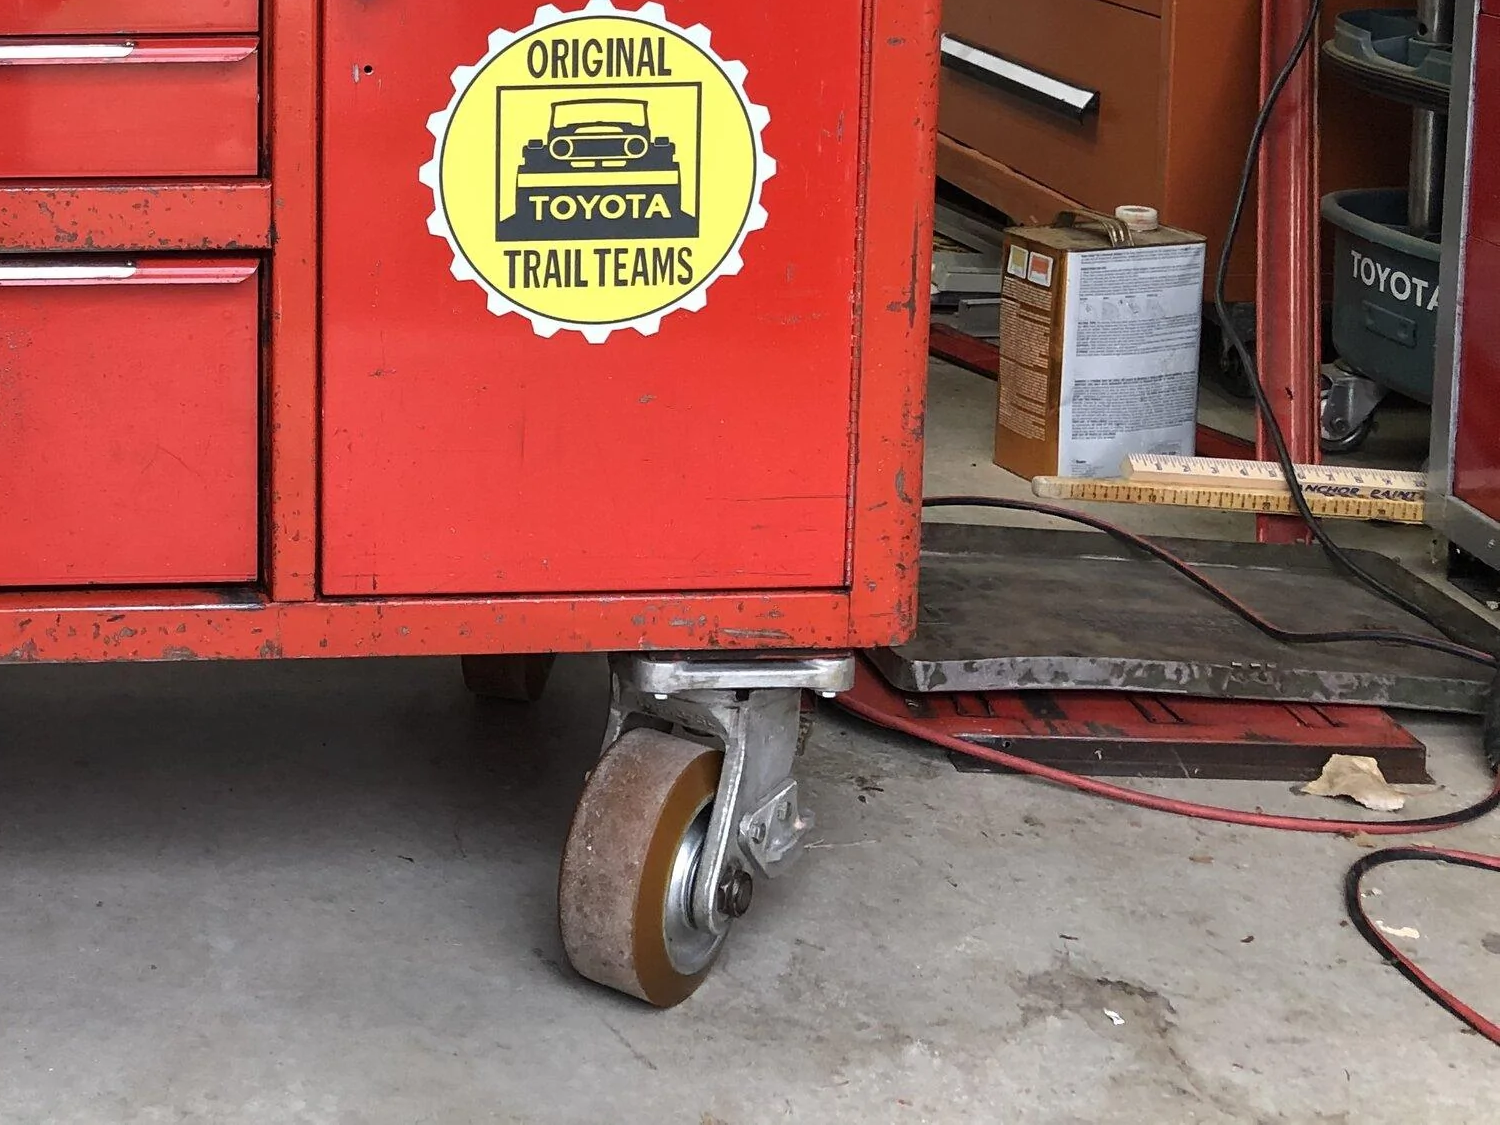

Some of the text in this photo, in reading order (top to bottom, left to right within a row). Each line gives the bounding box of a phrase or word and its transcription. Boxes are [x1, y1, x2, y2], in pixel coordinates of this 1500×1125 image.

[526, 37, 672, 79] ORIGINAL
[529, 194, 671, 221] TOYOTA
[503, 246, 693, 289] TRAIL TEAMS
